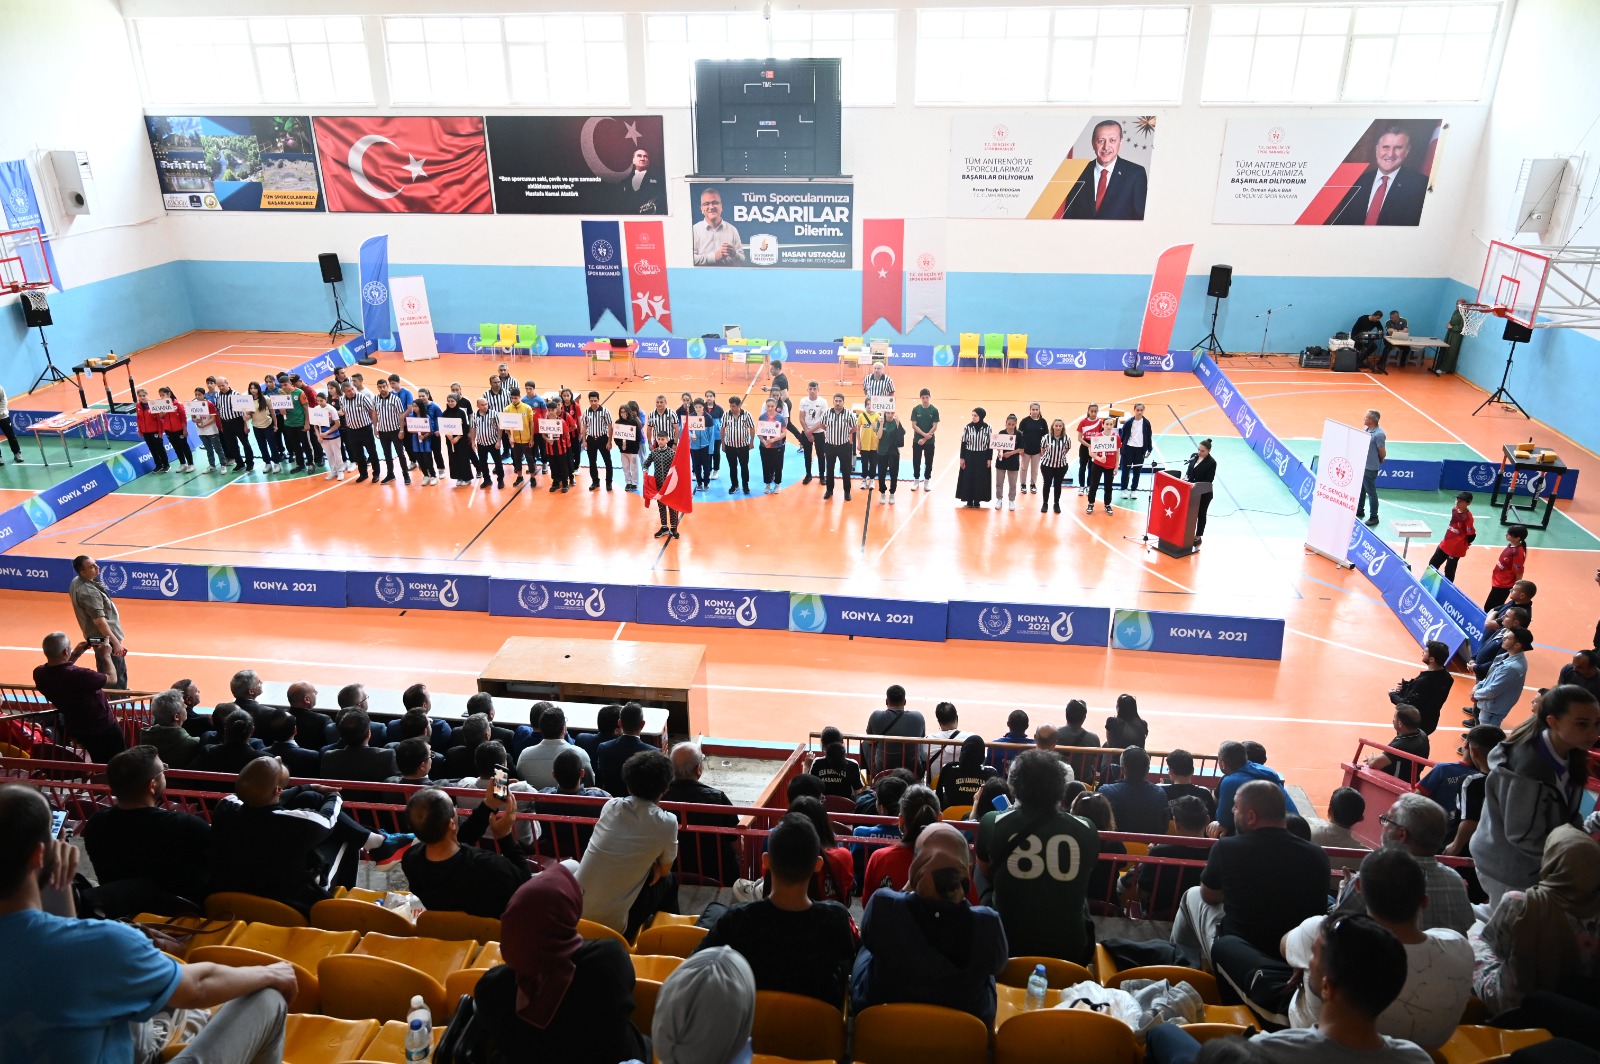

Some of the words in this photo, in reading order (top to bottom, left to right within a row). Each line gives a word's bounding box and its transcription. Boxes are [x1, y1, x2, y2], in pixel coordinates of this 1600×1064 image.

[965, 157, 981, 165] TÜM
[983, 157, 1024, 165] ANTRENÖR
[1236, 160, 1253, 168] TÜM
[1236, 169, 1304, 177] SPORCULARIMIZA
[742, 192, 766, 202] Tüm
[770, 192, 850, 205] Sporcularımıza
[734, 206, 850, 224] BAŞARILAR
[794, 225, 844, 236] Dilerim.
[1502, 471, 1528, 479] KOYA
[57, 489, 82, 506] KONYA
[82, 479, 98, 494] 2021
[1317, 490, 1330, 500] SPOR
[1319, 483, 1328, 492] T.C.
[1328, 488, 1349, 500] GENÇLİK
[0, 526, 14, 540] 021
[1362, 539, 1377, 556] KONYA
[1362, 550, 1374, 562] 2021
[26, 568, 49, 578] 2021
[132, 572, 158, 580] KONYA
[253, 580, 288, 591] KONYA
[292, 582, 317, 592] 2021
[554, 590, 584, 599] KONYA
[704, 600, 735, 608] KONYA
[714, 608, 736, 616] 2021
[841, 610, 881, 622] KONYA
[886, 614, 914, 624] 2021
[1418, 604, 1434, 624] KONYA
[1018, 614, 1050, 623] KONYA
[1418, 616, 1430, 630] 2021
[1442, 600, 1464, 626] KONYA
[1465, 622, 1484, 642] 2021
[1028, 623, 1050, 631] 2021
[1170, 627, 1212, 640] KONYA
[1218, 630, 1248, 642] 2021
[1006, 833, 1081, 882] 80
